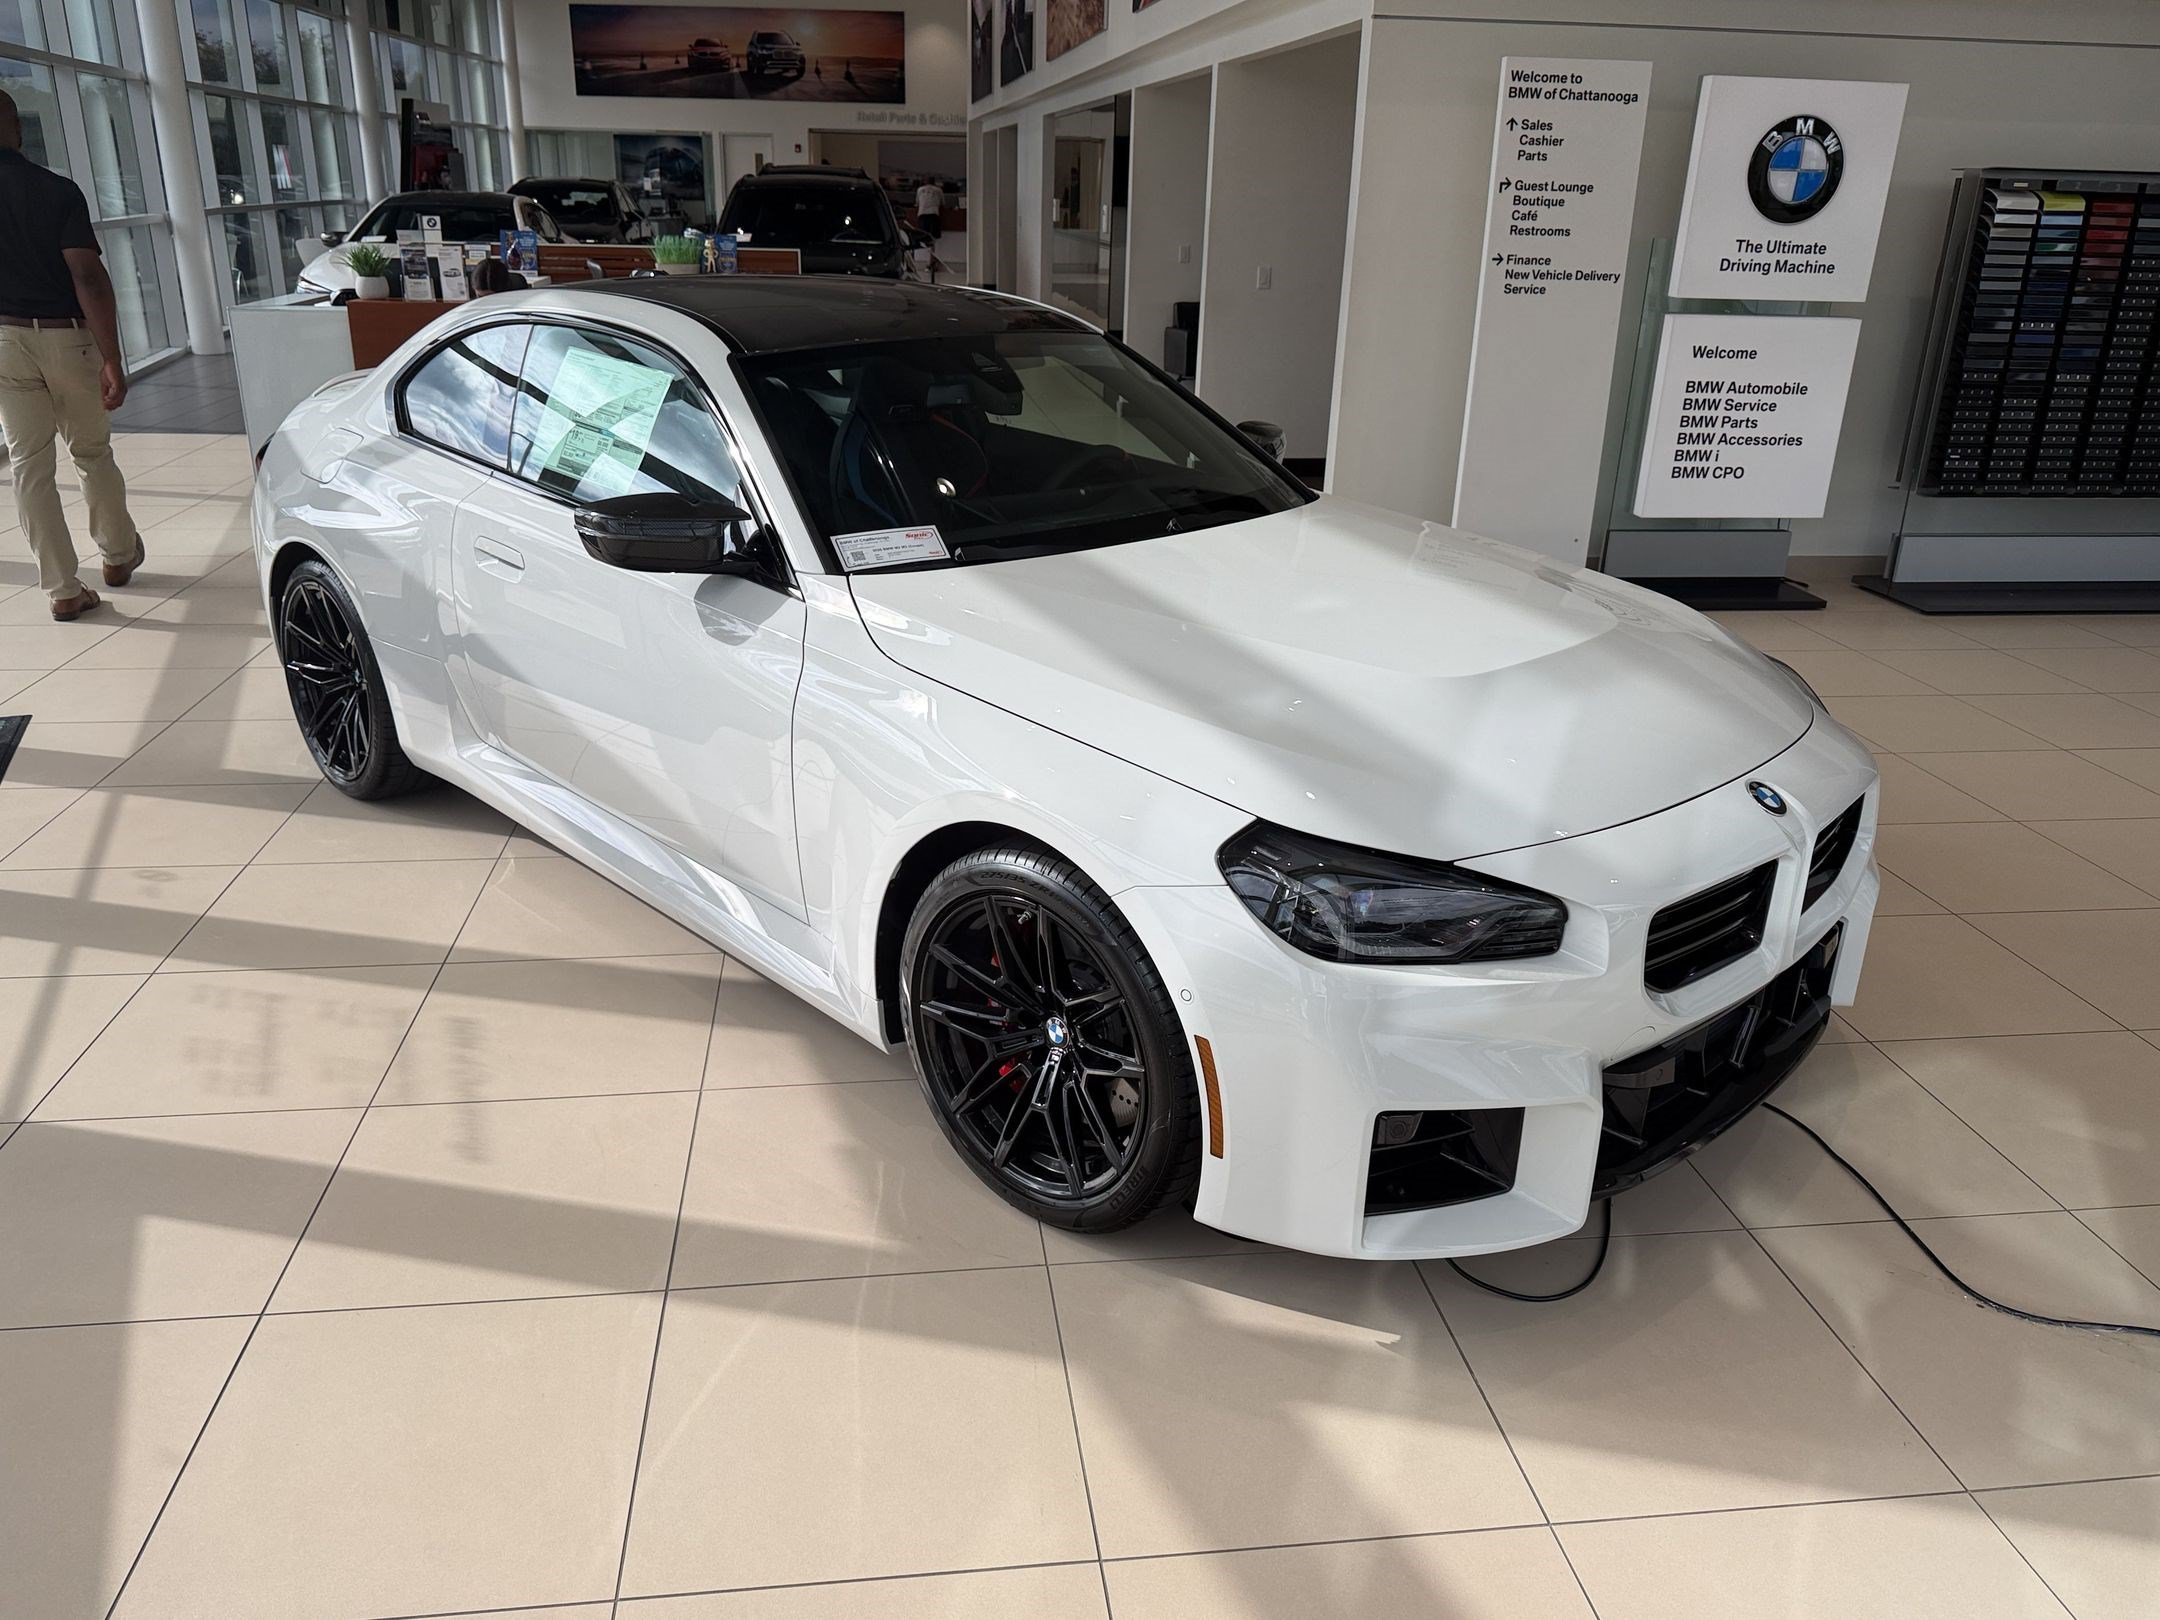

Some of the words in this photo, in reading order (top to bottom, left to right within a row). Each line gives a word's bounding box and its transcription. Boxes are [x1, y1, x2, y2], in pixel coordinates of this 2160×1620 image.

[1511, 70, 1568, 84] Welcome
[1570, 73, 1583, 84] to
[1508, 87, 1542, 99] BMW
[1544, 88, 1557, 100] of
[1559, 88, 1639, 105] Chattanooga
[1521, 119, 1553, 131] Sales
[1519, 134, 1565, 147] Cashier
[1762, 117, 1841, 154] BMW
[1517, 150, 1548, 161] Parts
[1515, 180, 1549, 192] Guest
[1551, 181, 1594, 195] Lounge
[1513, 195, 1566, 209] Boutique
[1511, 209, 1538, 221] Café
[1510, 225, 1571, 237] Restrooms
[1736, 239, 1763, 253] The
[1766, 240, 1827, 255] Ultimate
[1506, 254, 1552, 266] Finance
[1719, 258, 1771, 276] Driving
[1774, 260, 1835, 274] Machine
[1505, 269, 1530, 280] New
[1532, 269, 1573, 281] Vehicle
[1575, 270, 1621, 283] Delivery
[1504, 283, 1546, 295] Service
[1692, 345, 1758, 360] Welcome
[1685, 381, 1725, 394] BMW
[1726, 381, 1809, 395] Automobile
[1682, 398, 1722, 411] BMW
[1723, 398, 1777, 412] Service
[1679, 415, 1719, 428] BMW
[1721, 415, 1758, 429] Parts
[1677, 432, 1716, 445] BMW
[1717, 432, 1803, 446] Accessories
[1674, 449, 1713, 462] BMW
[1715, 450, 1720, 462] i
[1671, 466, 1710, 479] BMW
[1712, 466, 1745, 479] CPO
